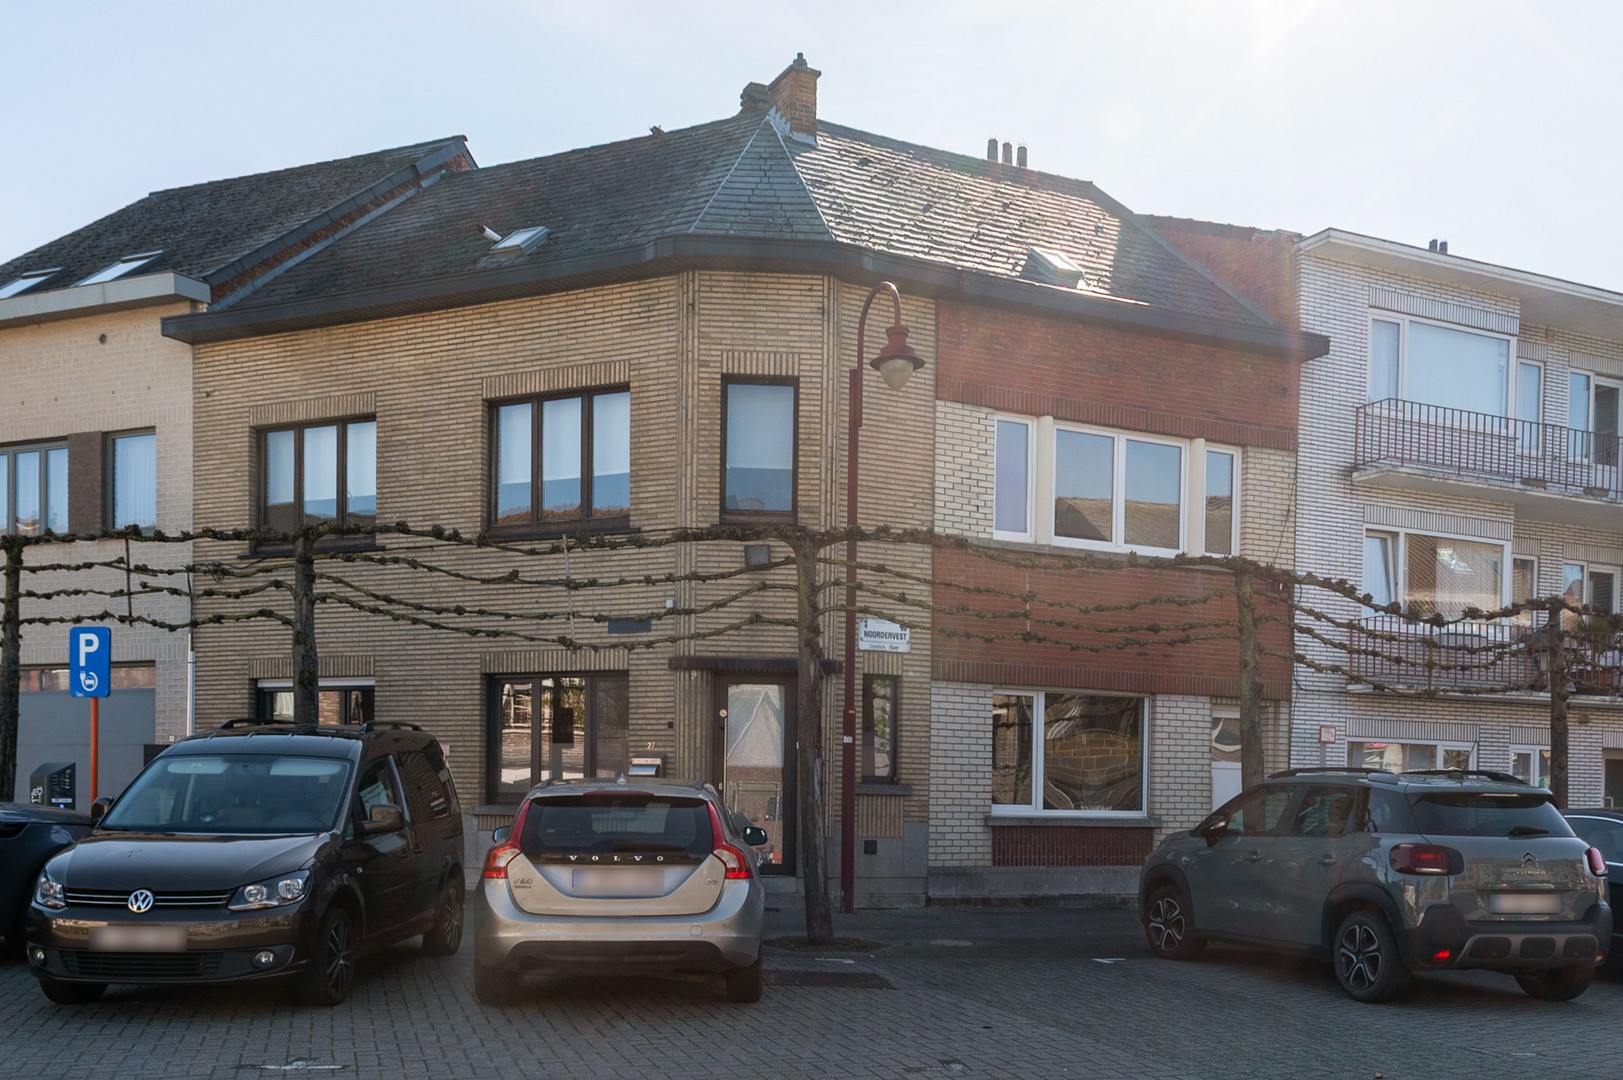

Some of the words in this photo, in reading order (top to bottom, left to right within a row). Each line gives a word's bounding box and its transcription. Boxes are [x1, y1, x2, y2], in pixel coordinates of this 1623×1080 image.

[863, 630, 907, 641] NOORDERVEST
[79, 633, 99, 667] P
[646, 741, 656, 750] 27
